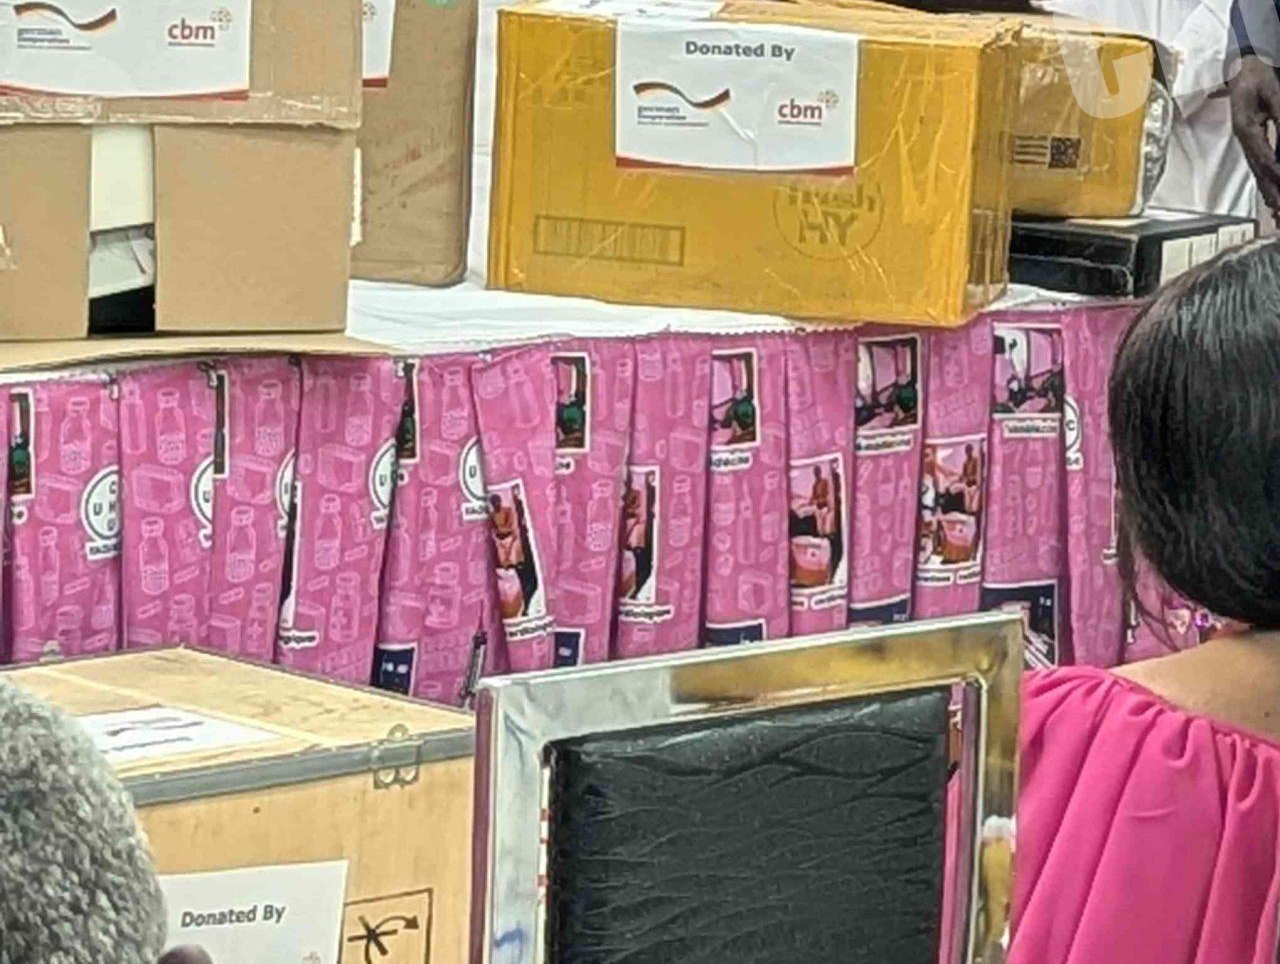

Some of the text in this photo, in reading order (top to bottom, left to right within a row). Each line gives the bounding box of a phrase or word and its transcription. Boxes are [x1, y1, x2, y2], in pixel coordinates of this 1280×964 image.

[168, 17, 216, 40] cbm
[685, 40, 796, 62] Donated By
[778, 98, 823, 120] cbm
[181, 904, 286, 928] Donated By
